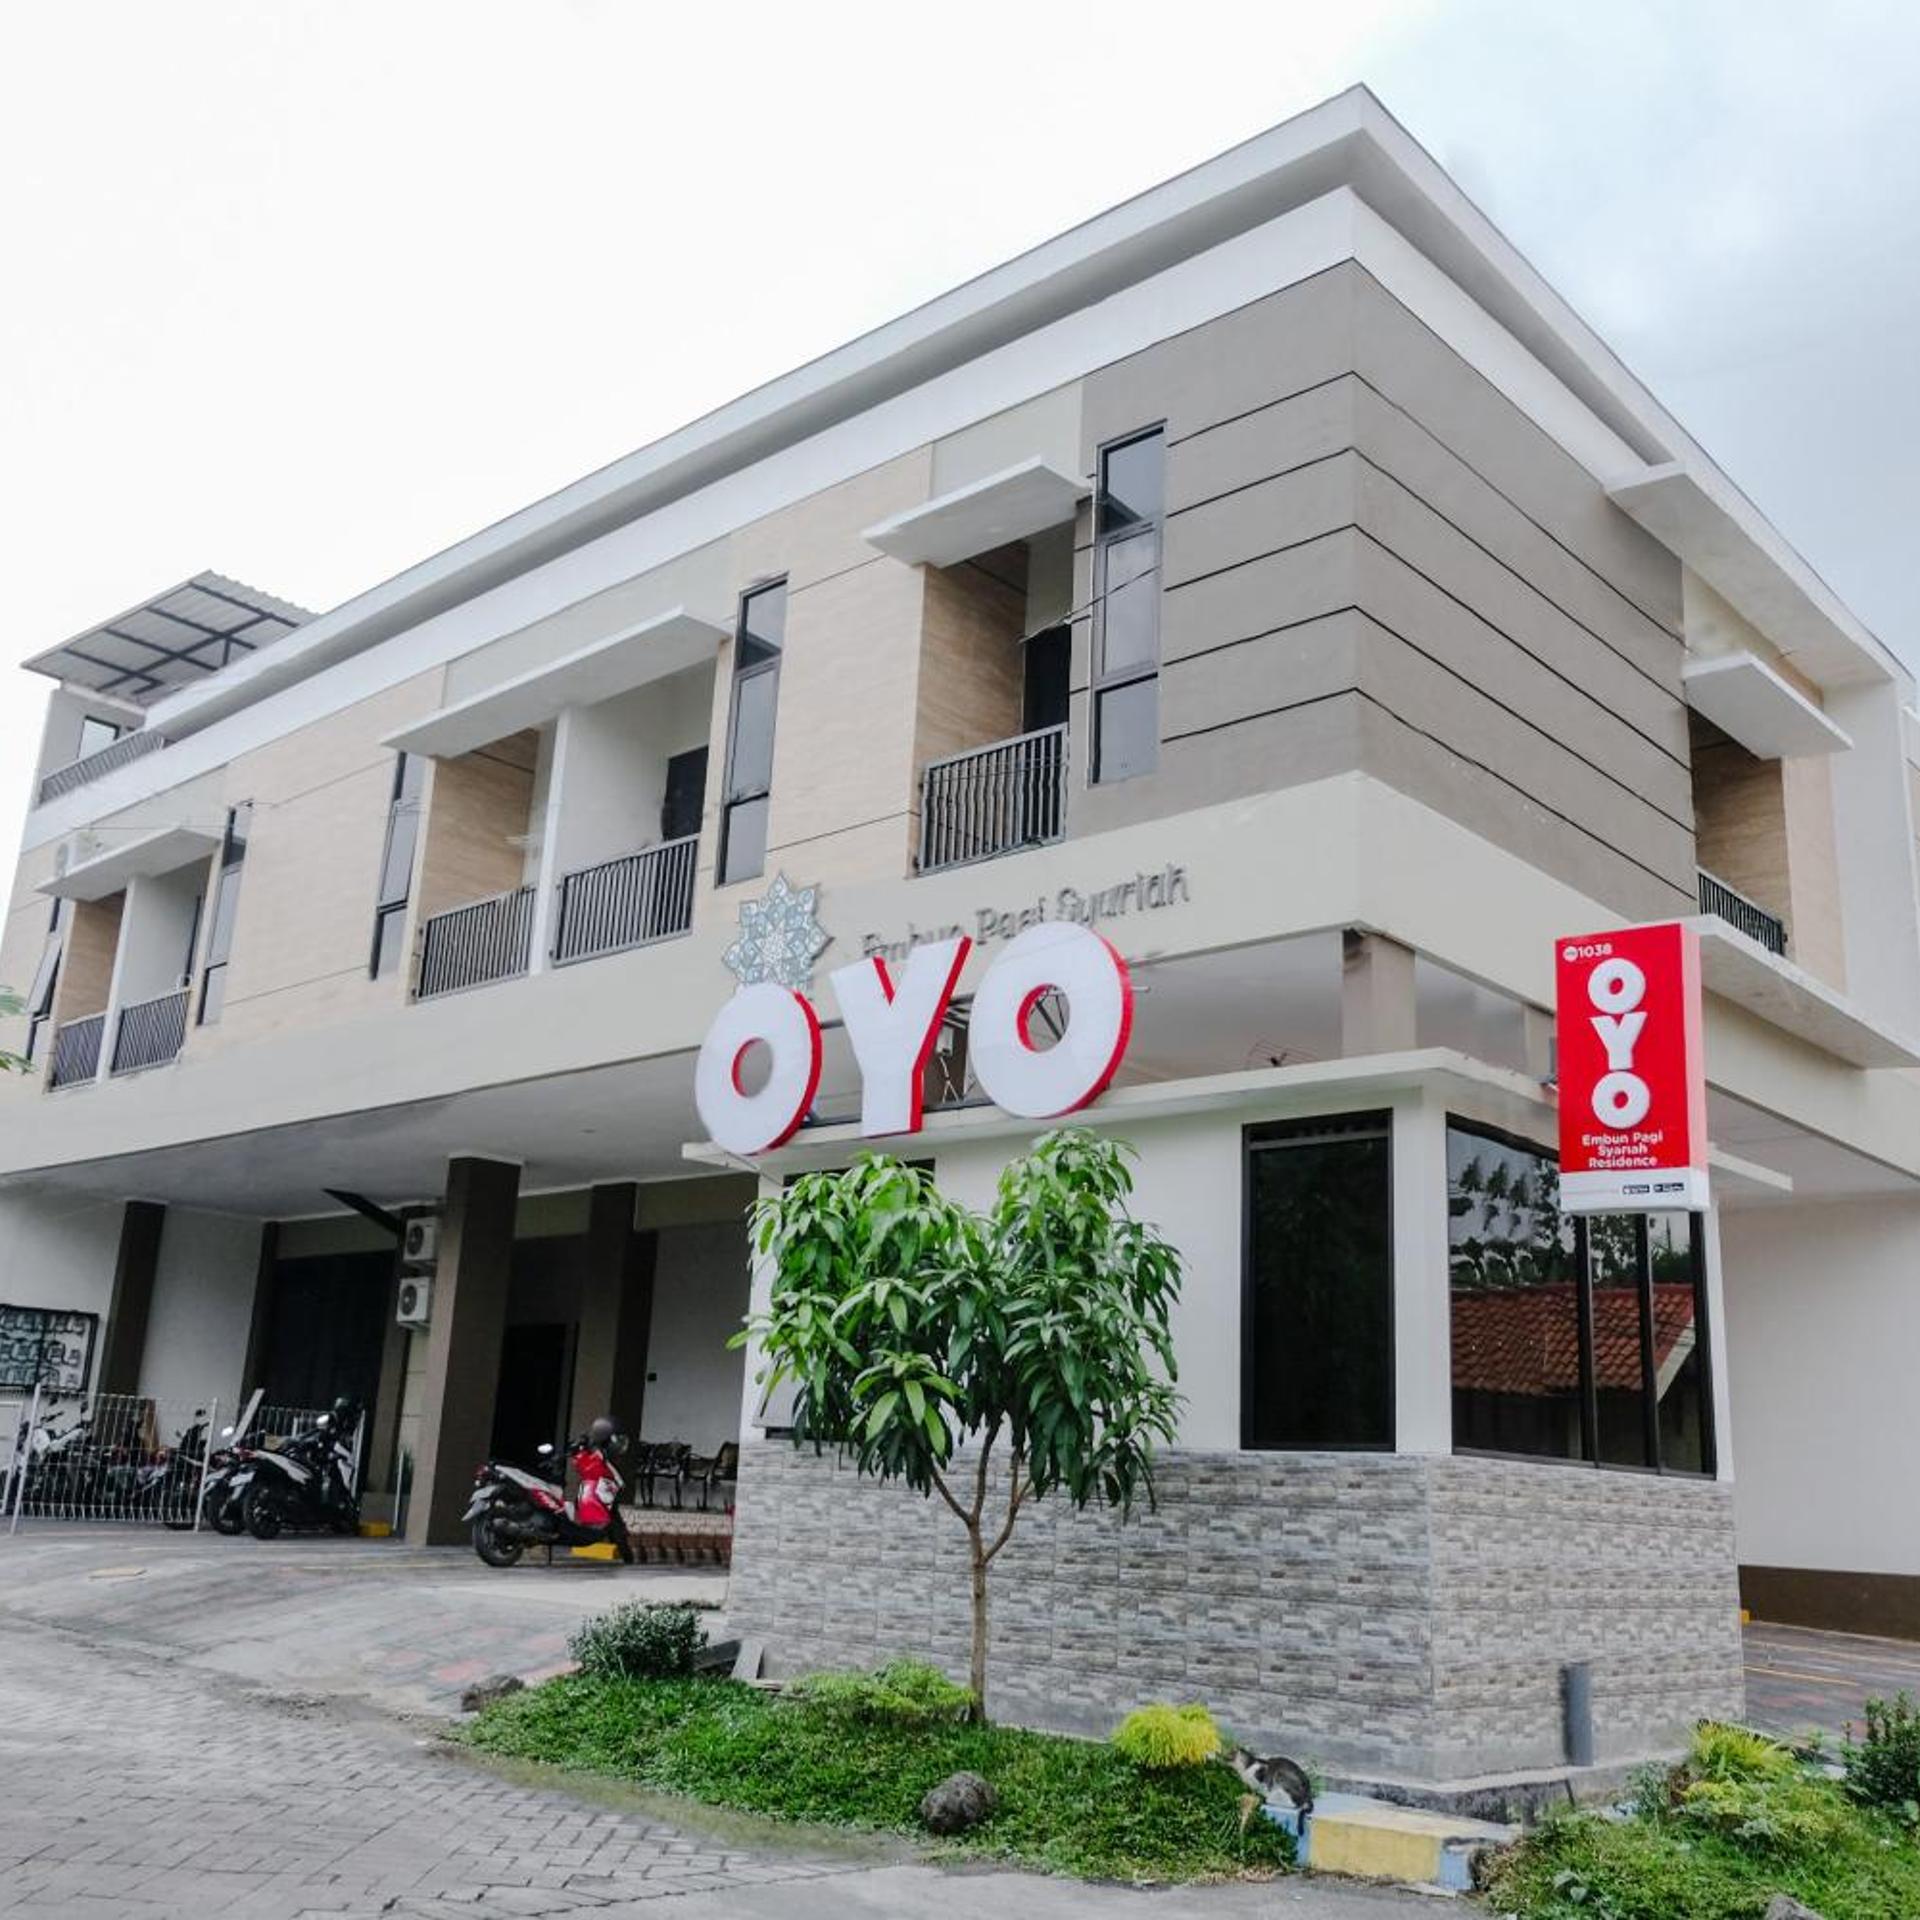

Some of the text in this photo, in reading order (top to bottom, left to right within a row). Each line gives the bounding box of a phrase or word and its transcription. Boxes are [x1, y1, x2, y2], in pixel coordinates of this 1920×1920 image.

[1578, 943, 1613, 958] 1038
[695, 921, 1134, 1157] OYO
[1587, 957, 1650, 1130] OYO
[1582, 1129, 1664, 1147] Embun Pagi
[1598, 1142, 1648, 1157] Syariah
[1589, 1156, 1658, 1168] Residence
